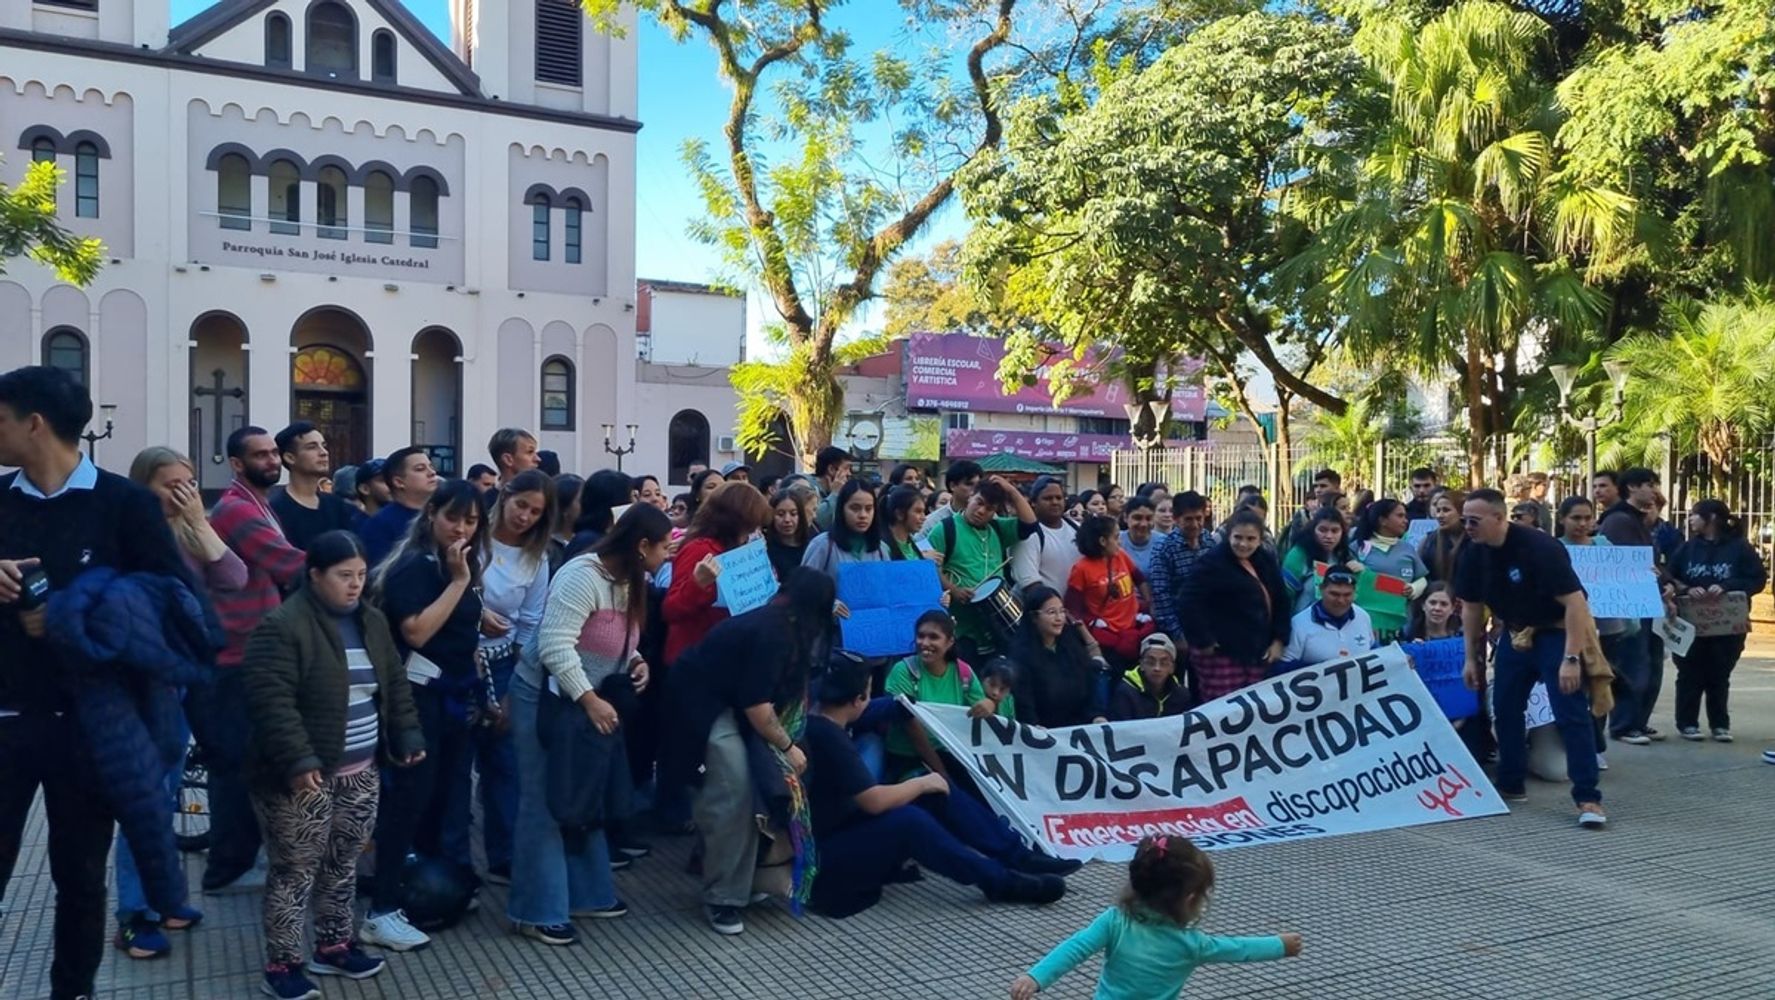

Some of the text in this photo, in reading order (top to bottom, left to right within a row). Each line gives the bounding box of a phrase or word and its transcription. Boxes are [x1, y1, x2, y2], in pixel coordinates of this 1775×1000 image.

[223, 241, 430, 269] Parroquia San José Iglesia Catedral
[912, 356, 982, 370] LIBRERÍA ESCOLAR,
[912, 366, 956, 377] COMERCIAL
[912, 375, 958, 386] Y ARTISTICA
[1572, 547, 1624, 564] PACIDAD
[1578, 564, 1638, 584] RGENCIA
[1591, 602, 1649, 617] STENCIA
[1069, 724, 1146, 763] AL
[1179, 653, 1389, 748] AJUSTE
[1055, 693, 1422, 801] DISCAPACIDAD
[1222, 808, 1261, 829] en
[1266, 741, 1447, 824] discapacidad
[1416, 763, 1483, 817] ya!
[1188, 823, 1326, 850] SIONES
